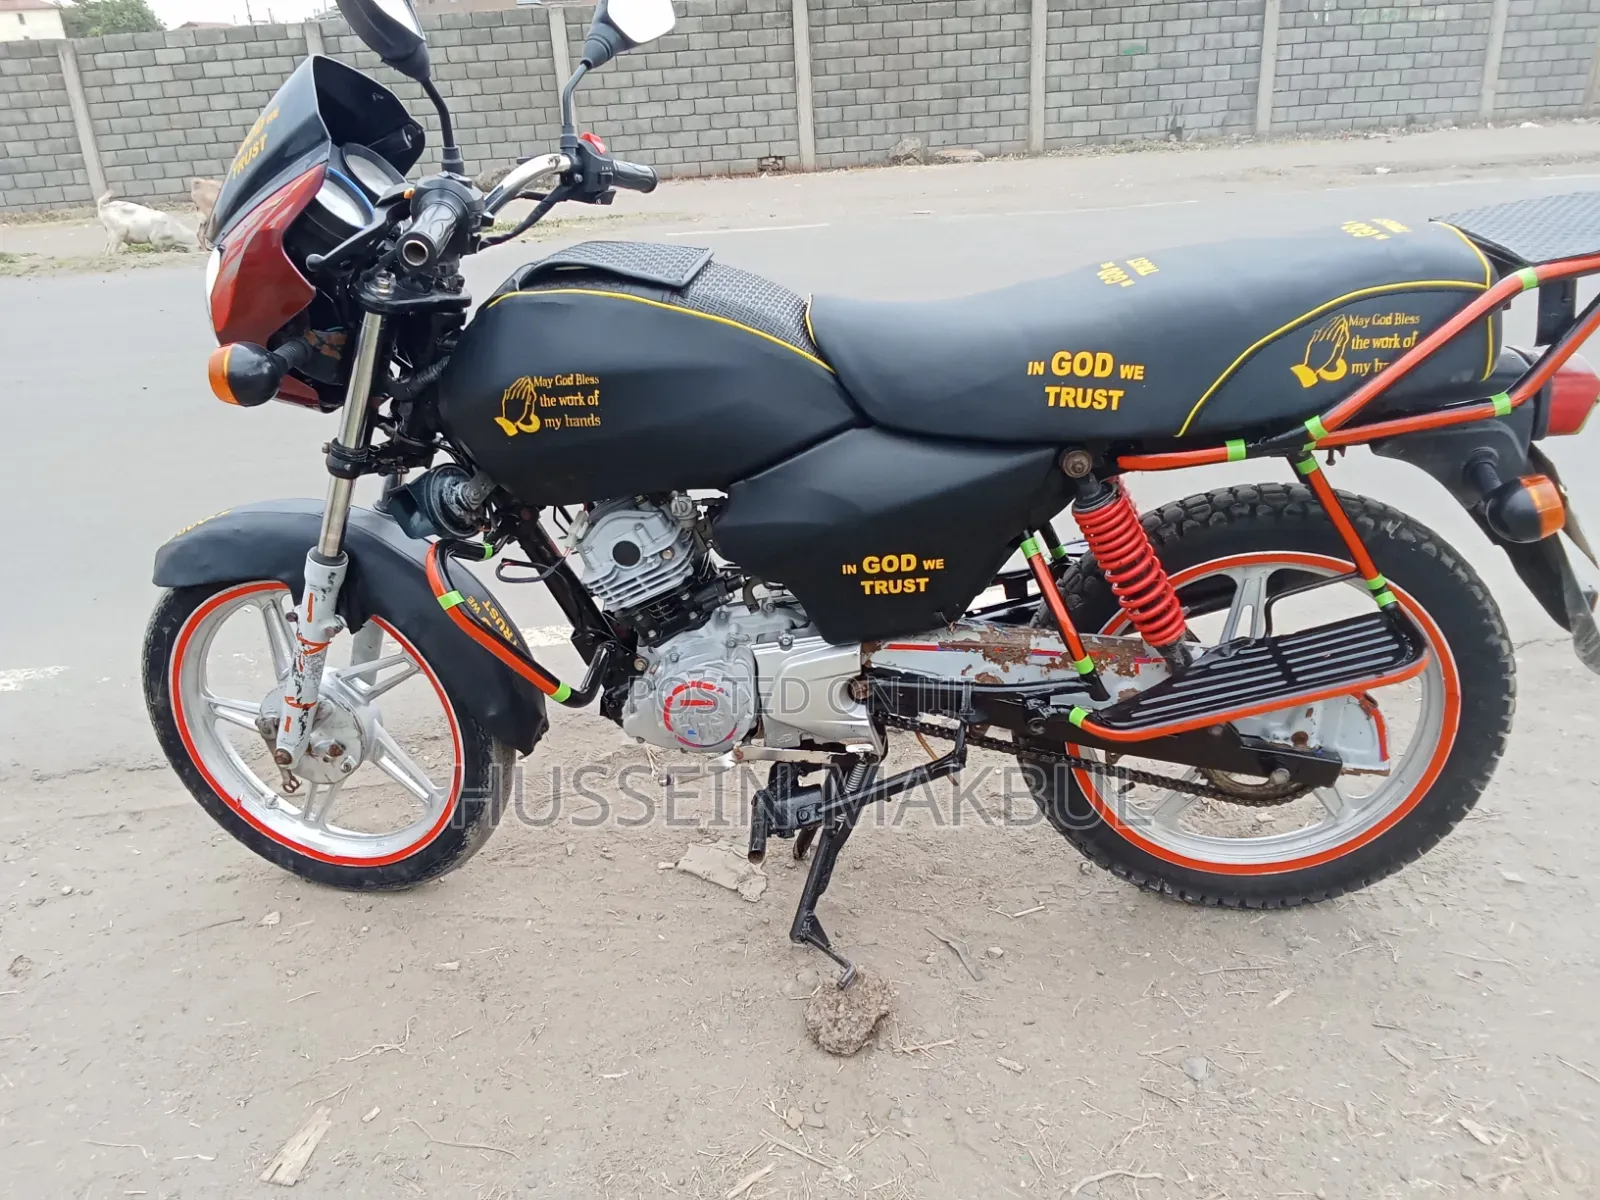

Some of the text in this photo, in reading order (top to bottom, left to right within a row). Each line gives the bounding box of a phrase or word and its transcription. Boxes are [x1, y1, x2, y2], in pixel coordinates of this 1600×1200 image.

[232, 132, 268, 179] TRUST
[1349, 312, 1420, 328] May God Bless
[1351, 330, 1419, 350] the work of
[1027, 350, 1145, 381] IN GOD WE
[1351, 362, 1371, 377] my
[533, 373, 600, 389] May God Bless
[539, 389, 600, 407] the work of
[1044, 386, 1125, 411] TRUST
[544, 413, 601, 430] my hands
[842, 553, 945, 575] IN GOD WE
[860, 577, 930, 595] TRUST
[466, 595, 482, 614] WE
